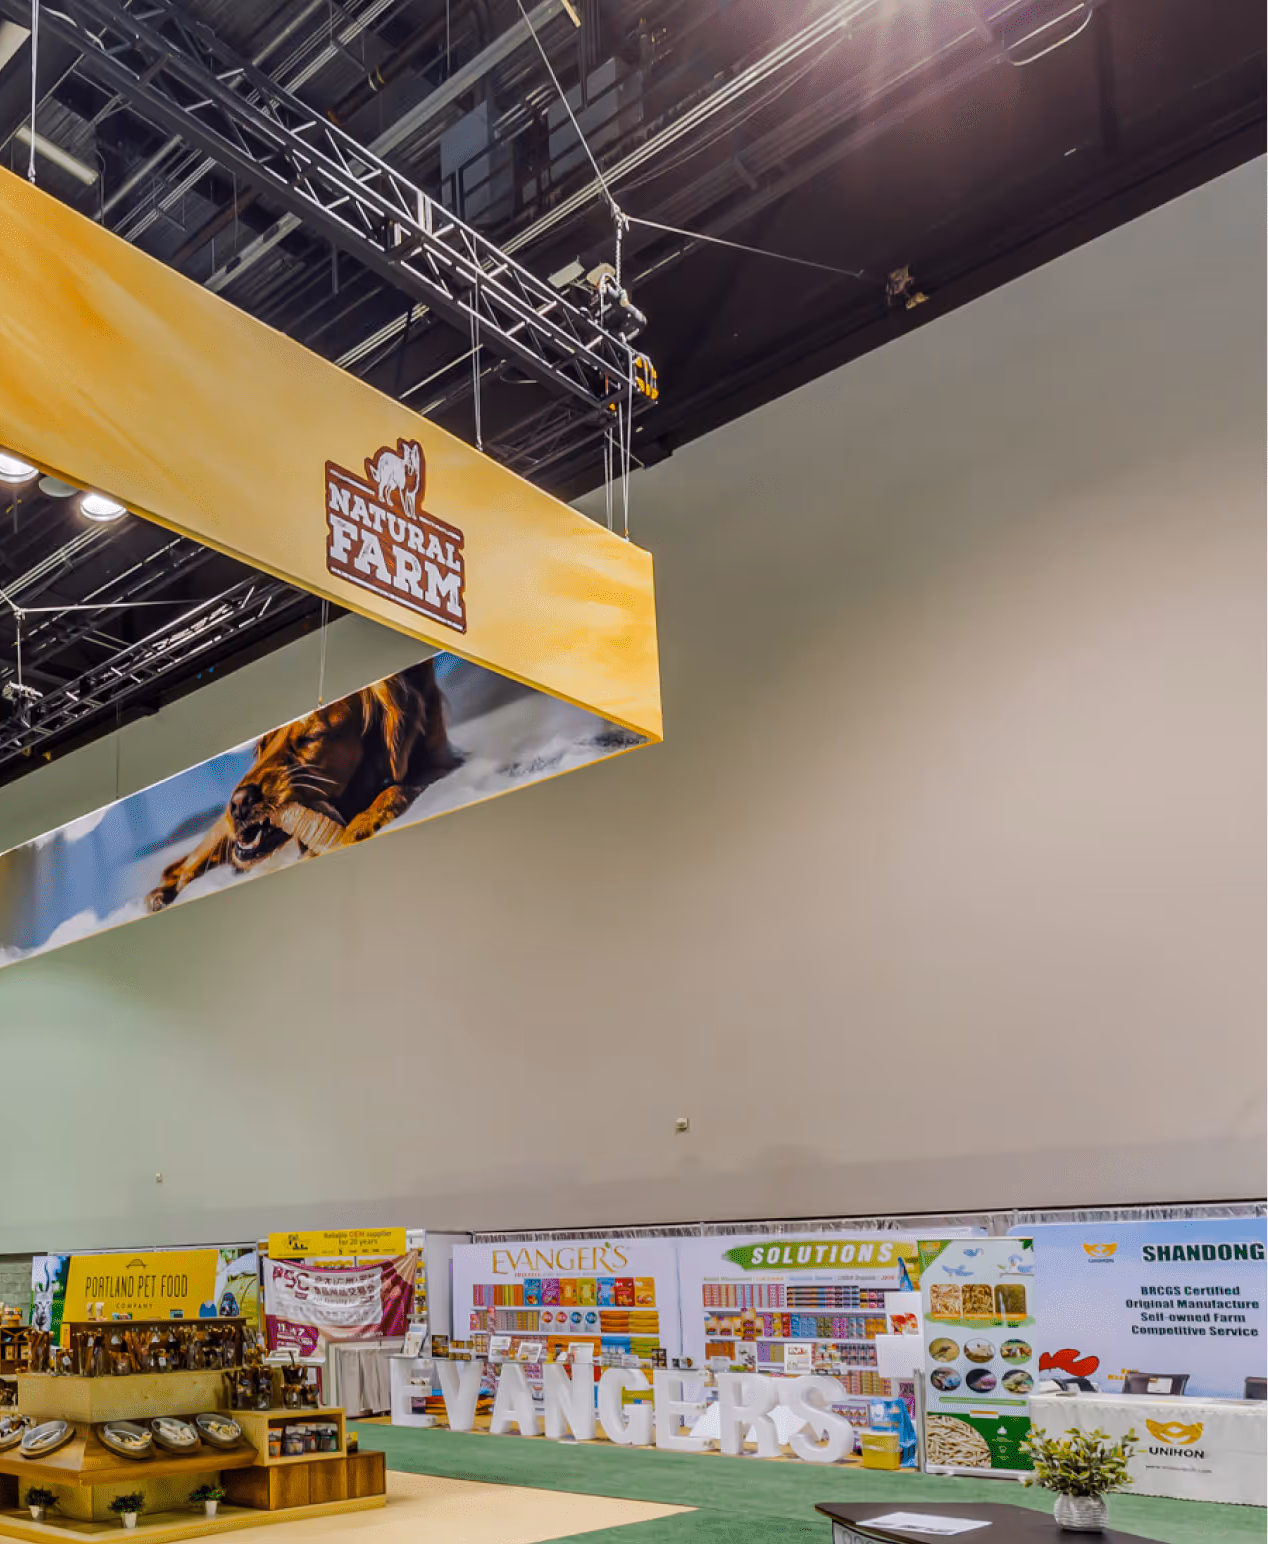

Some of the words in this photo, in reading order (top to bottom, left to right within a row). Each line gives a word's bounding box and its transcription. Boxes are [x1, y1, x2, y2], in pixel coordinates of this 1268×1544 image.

[328, 481, 462, 573] NATURAL
[329, 513, 463, 618] FARM
[491, 1241, 629, 1275] EVANGER'S
[750, 1242, 894, 1265] SOLUTIONS
[1141, 1242, 1266, 1263] SHANDONG
[85, 1275, 135, 1298] PORTLAND
[137, 1274, 157, 1298] PET
[161, 1273, 188, 1298] FOOD
[1140, 1286, 1181, 1296] BRCGS
[1183, 1285, 1241, 1296] Certified
[1125, 1299, 1174, 1310] Original
[1176, 1299, 1260, 1309] Manufacture
[1140, 1312, 1211, 1322] Self-owned
[1213, 1312, 1247, 1323] Farm
[1131, 1325, 1207, 1336] Competitive
[1208, 1326, 1259, 1337] Service
[389, 1356, 854, 1463] EVANGERS
[1148, 1446, 1205, 1459] UNIHON
